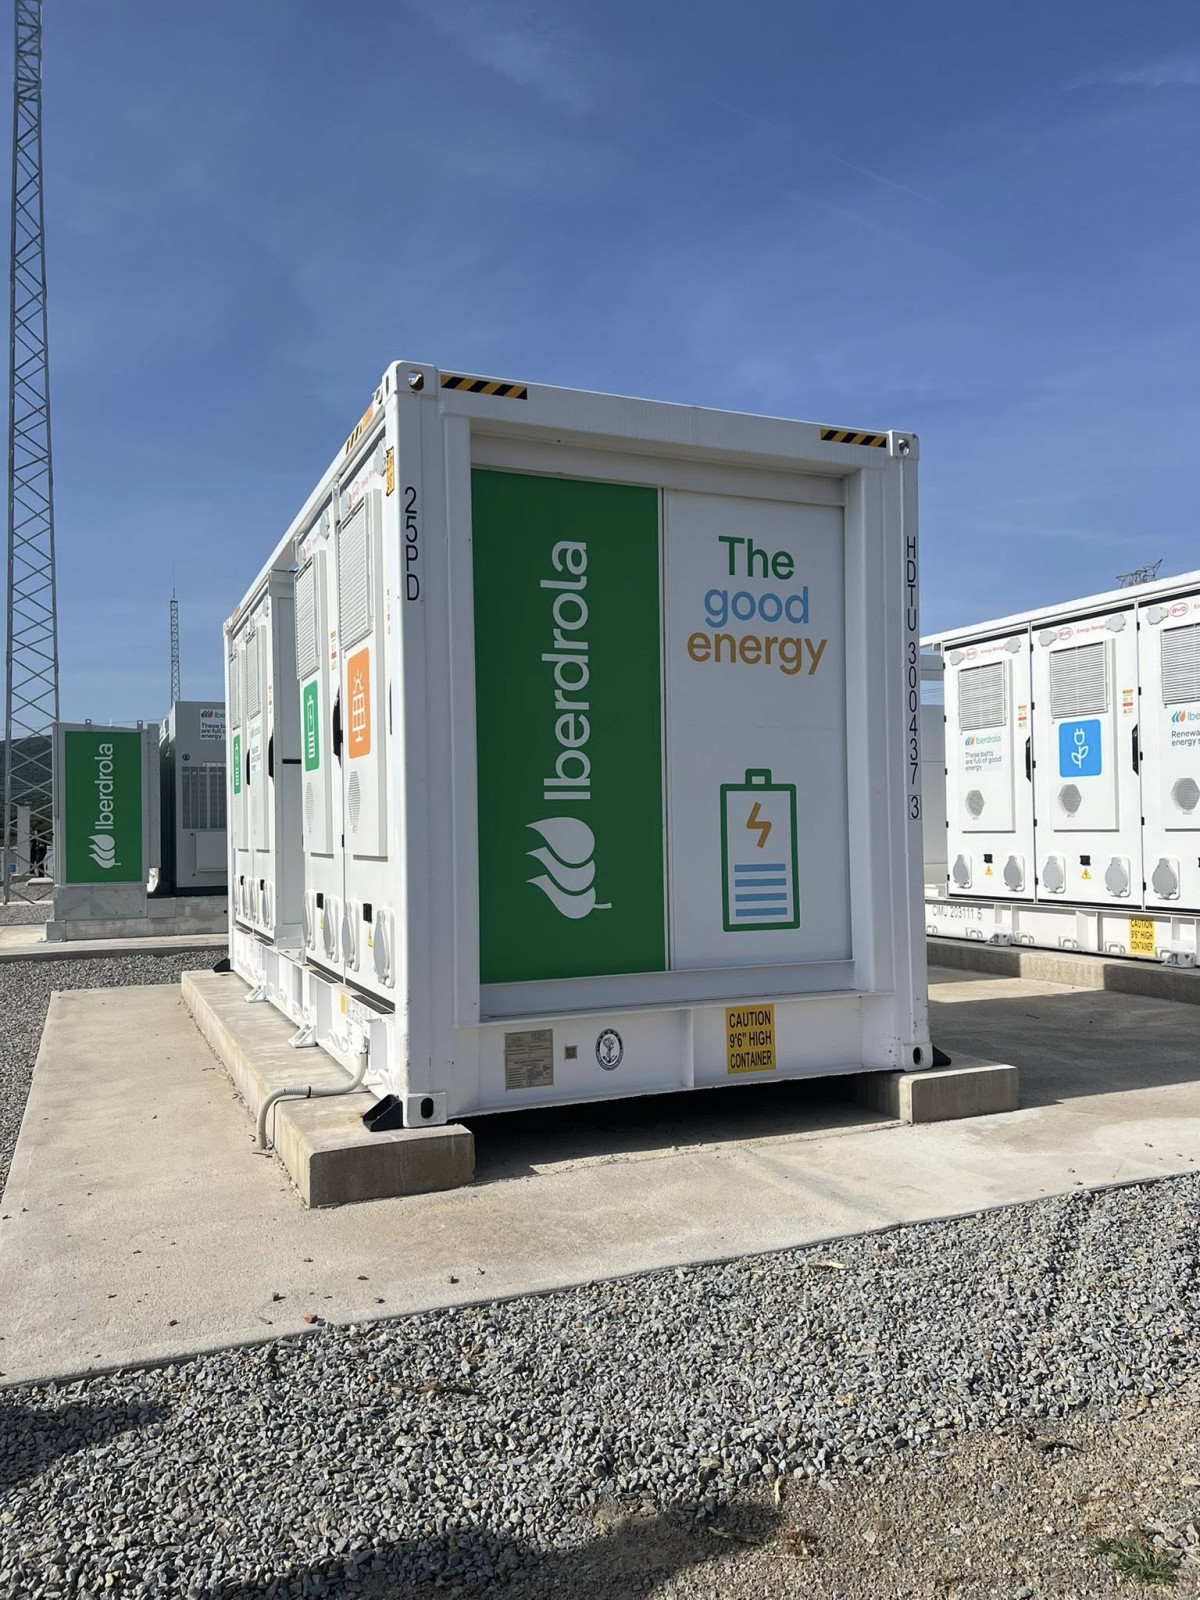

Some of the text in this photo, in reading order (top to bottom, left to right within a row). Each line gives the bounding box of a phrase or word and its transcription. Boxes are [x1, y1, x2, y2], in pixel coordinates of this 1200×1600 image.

[404, 486, 420, 601] 25PD
[718, 535, 794, 580] The
[704, 586, 809, 628] good
[687, 632, 828, 675] energy
[540, 540, 591, 800] Iberdrola
[907, 535, 920, 819] HDTU 300437 3
[976, 735, 1001, 744] Iberdrola
[1171, 739, 1196, 747] energy
[94, 743, 114, 829] Iberdrola
[1131, 918, 1152, 929] CAUTION
[1140, 931, 1152, 940] HIGH
[1131, 941, 1152, 951] CONTAINER
[729, 1010, 771, 1028] CAUTION
[749, 1030, 772, 1047] HIGH
[730, 1050, 773, 1069] CONTAINER
